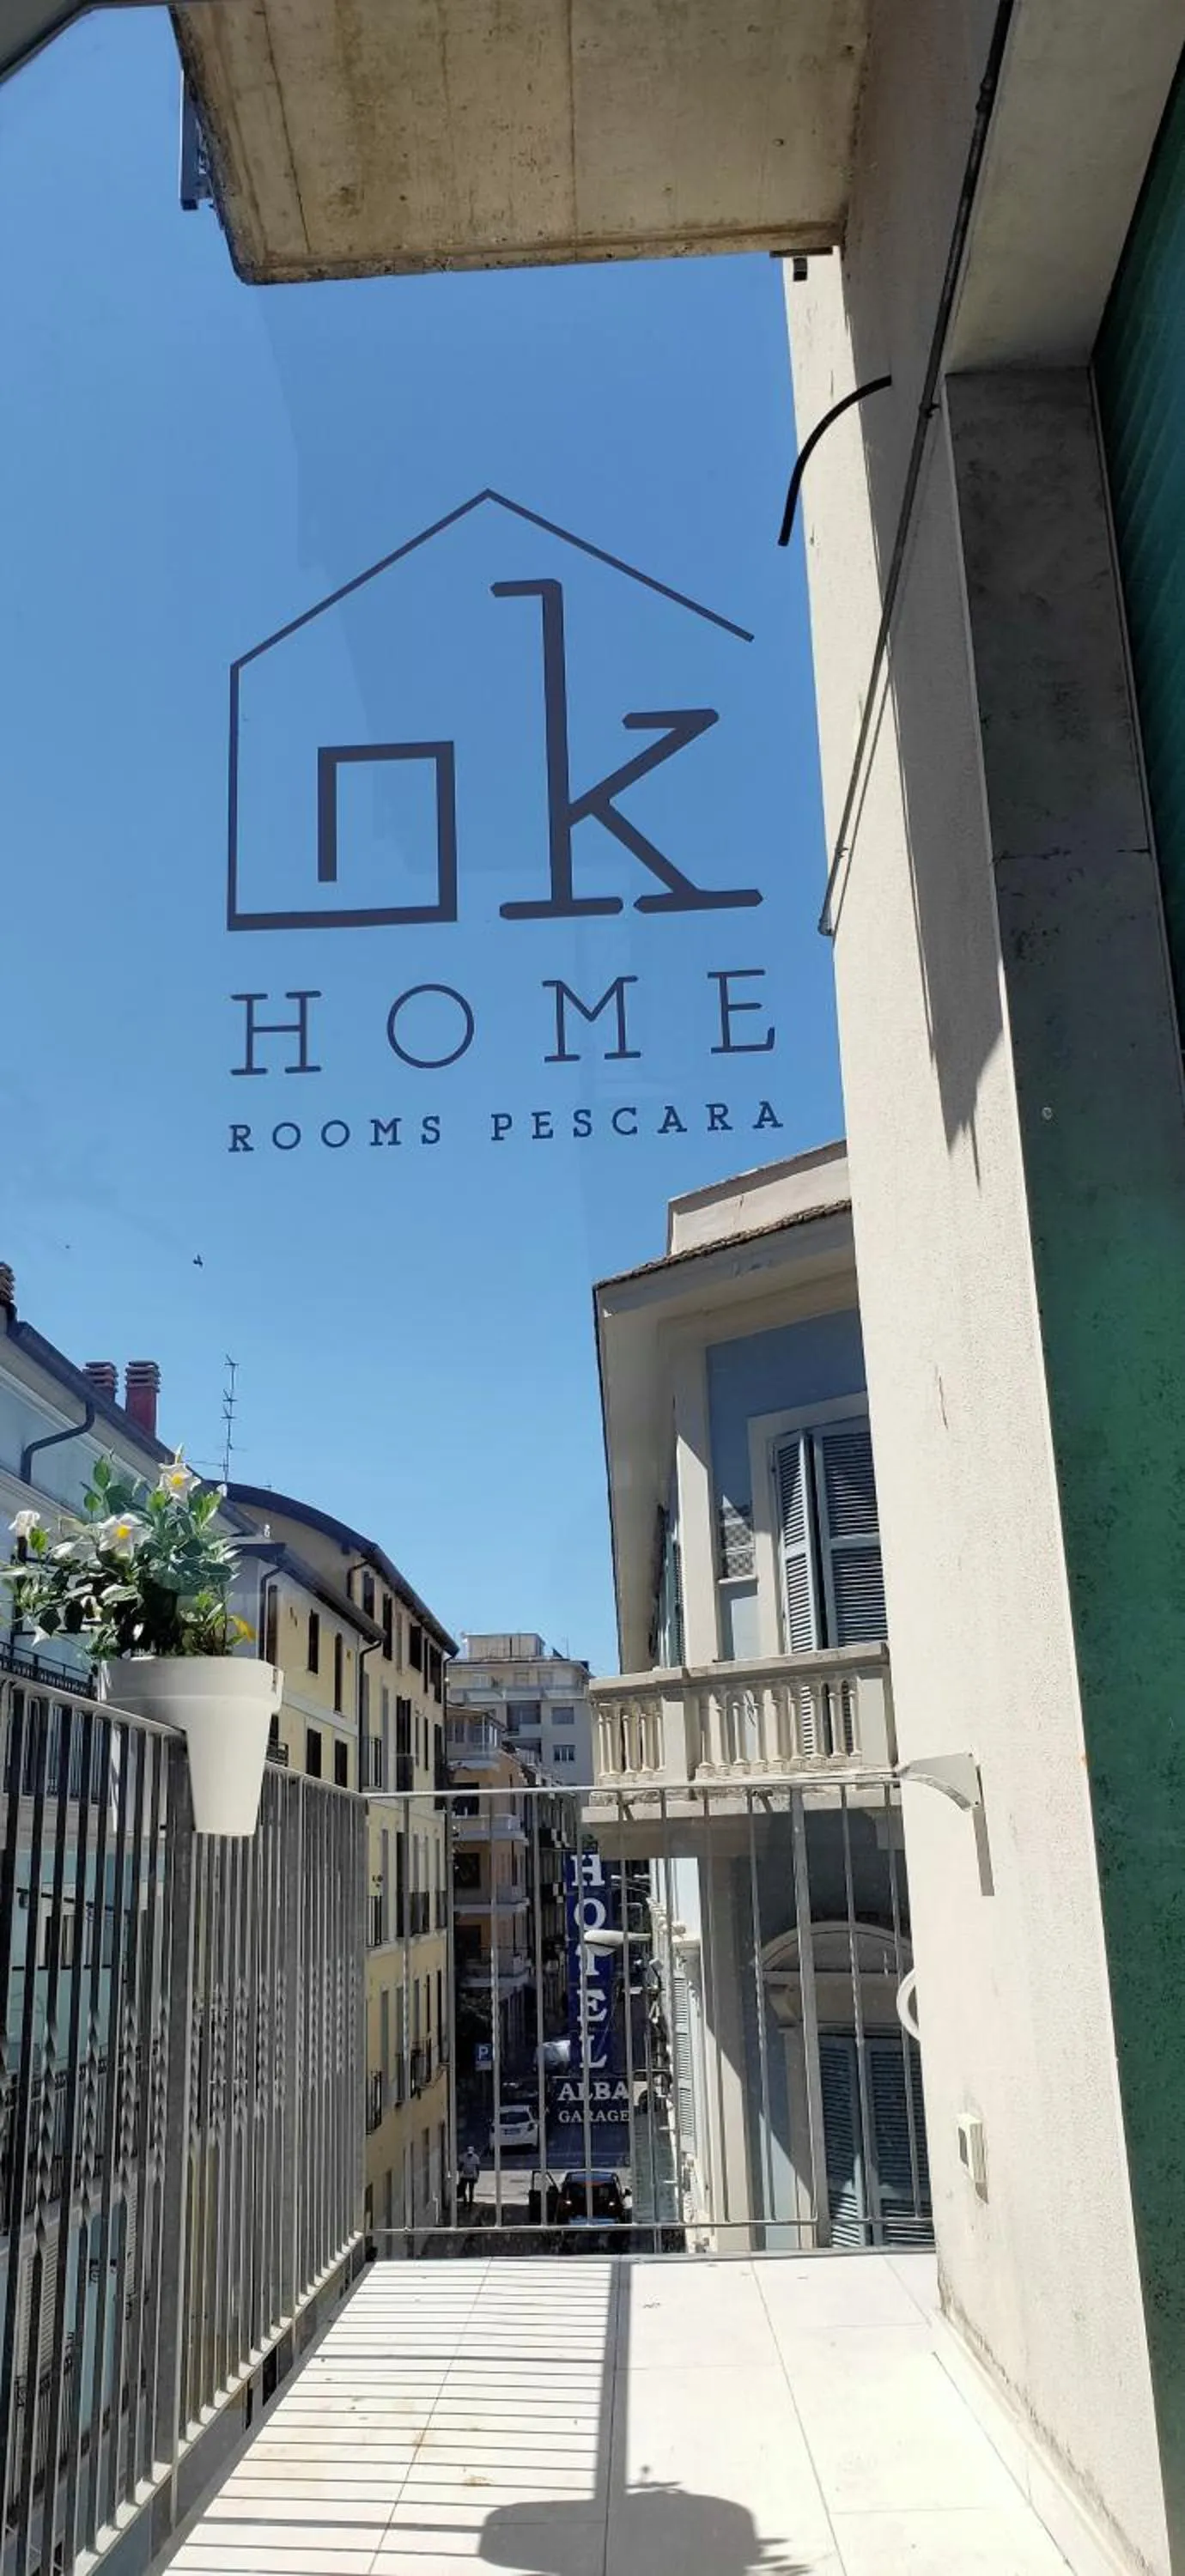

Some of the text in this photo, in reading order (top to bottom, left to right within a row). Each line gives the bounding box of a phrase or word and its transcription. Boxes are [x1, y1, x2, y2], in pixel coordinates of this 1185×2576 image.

[230, 969, 775, 1075] HOME
[228, 1101, 784, 1152] ROOMS PESCARA
[570, 1854, 607, 2069] HOTEL
[478, 2045, 489, 2061] P
[556, 2081, 630, 2101] ALBA
